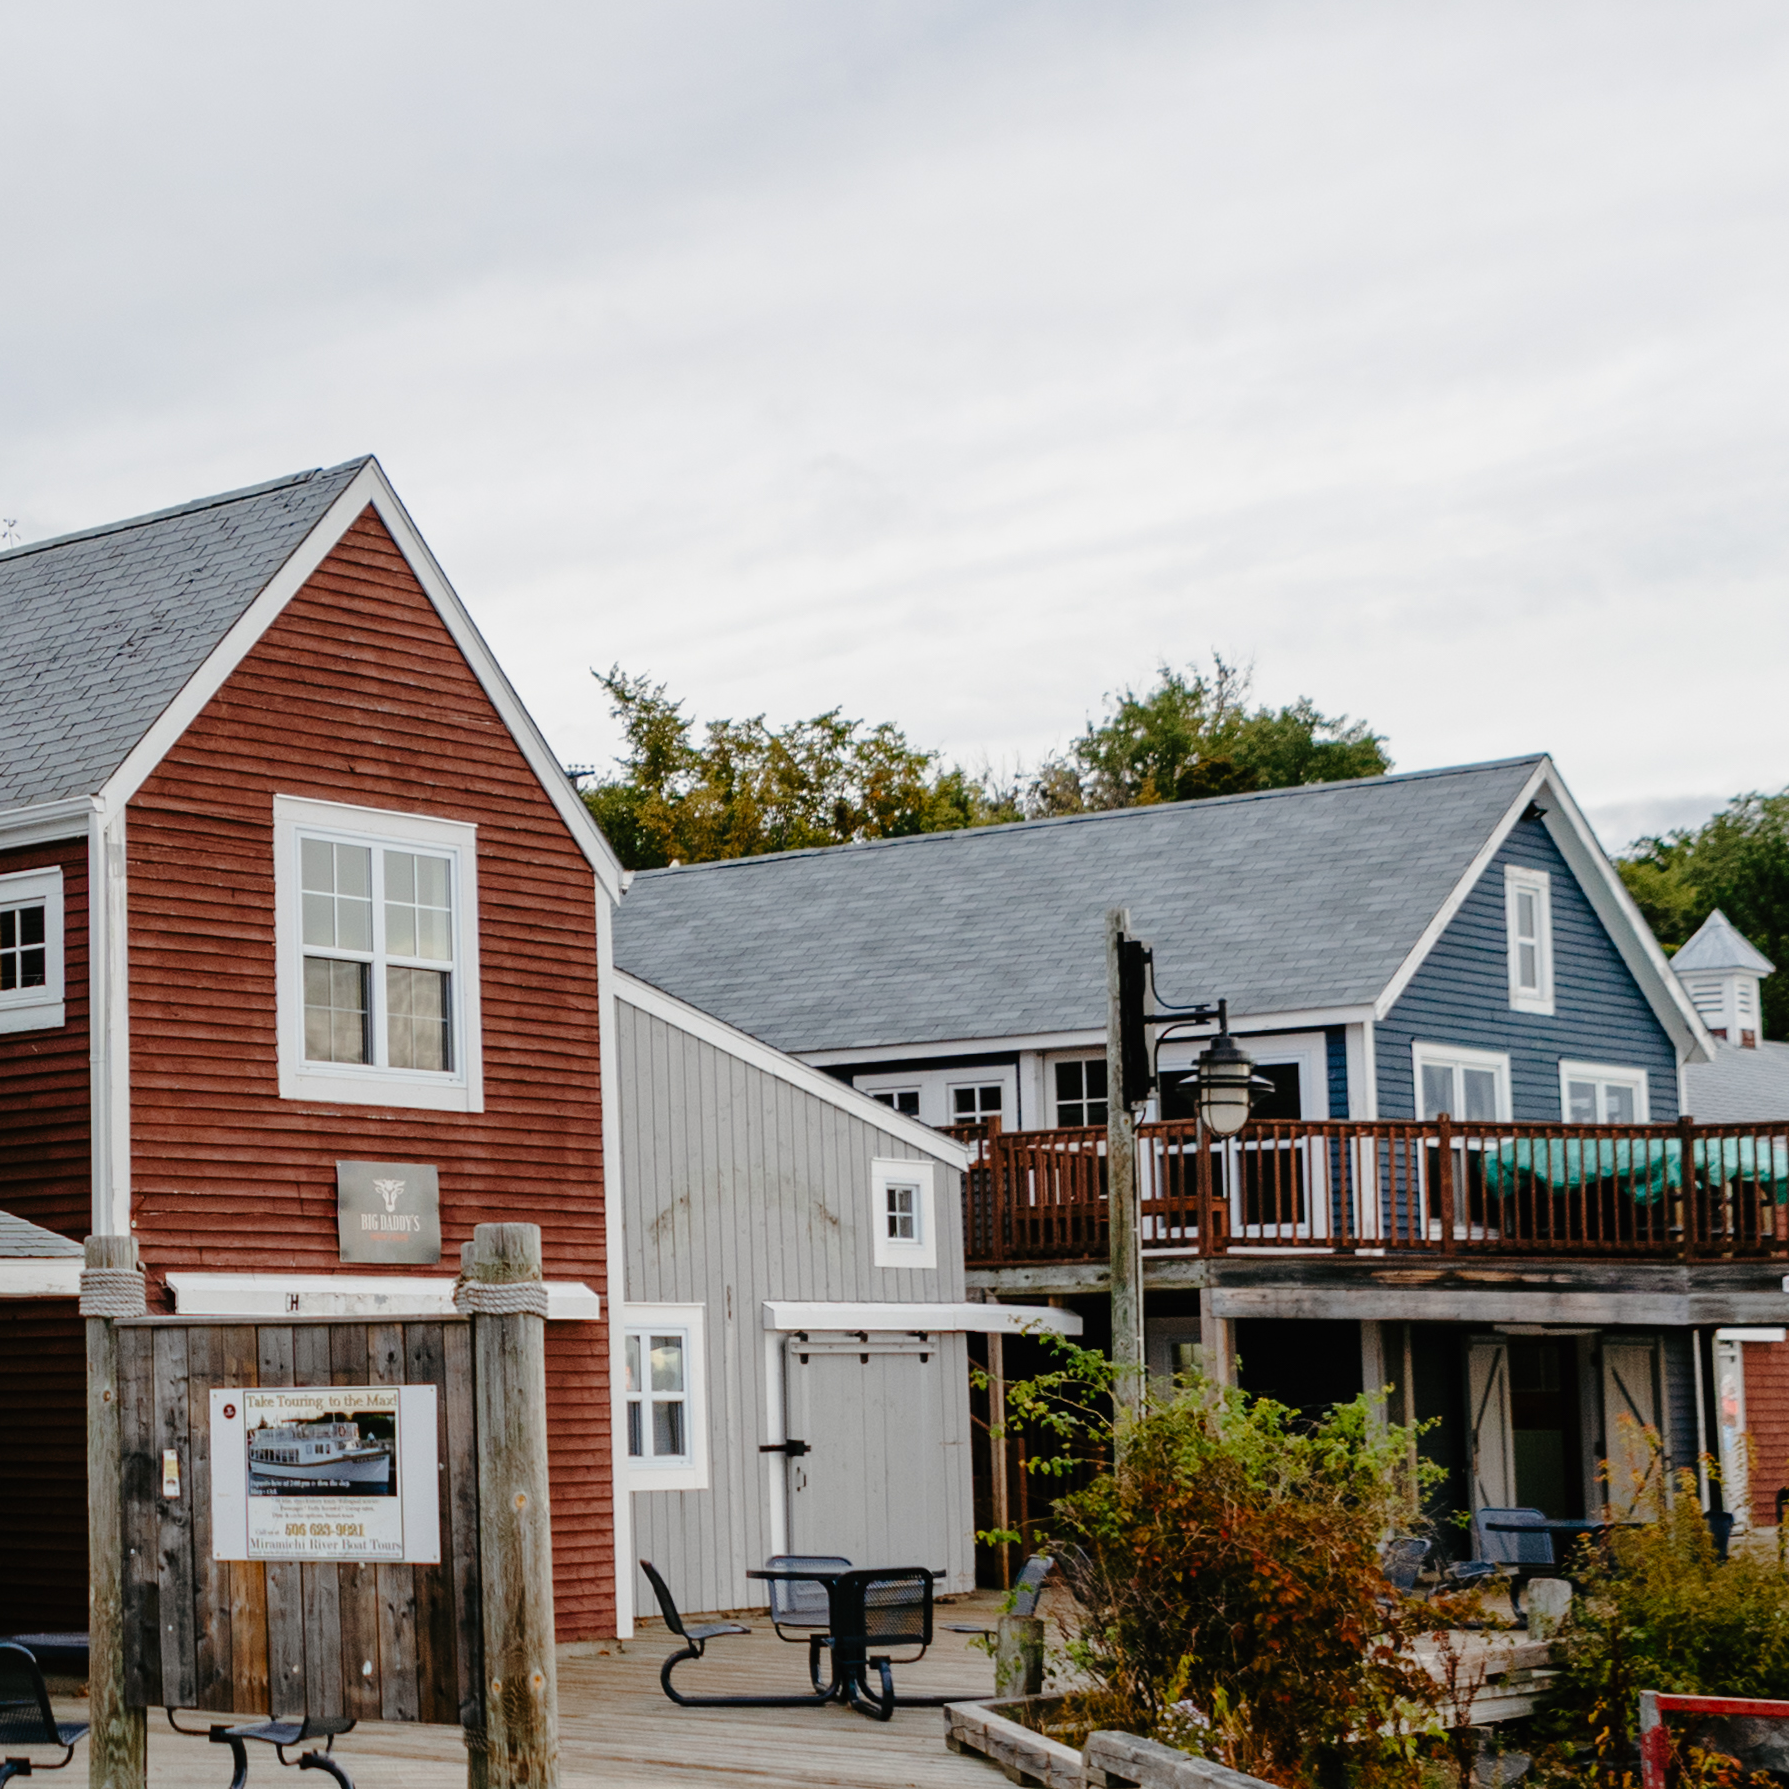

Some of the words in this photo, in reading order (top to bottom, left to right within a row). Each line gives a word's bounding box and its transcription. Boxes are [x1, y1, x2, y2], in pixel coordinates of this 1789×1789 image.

[361, 1214, 378, 1230] BIG
[380, 1214, 420, 1231] DADDY'S
[246, 1396, 274, 1408] Take
[276, 1395, 324, 1410] Touring
[329, 1396, 341, 1406] to
[344, 1394, 363, 1406] the
[366, 1394, 398, 1406] Max!
[285, 1523, 307, 1537] 506
[250, 1538, 305, 1550] Miramichi
[310, 1538, 339, 1550] River
[342, 1538, 367, 1550] Boat
[369, 1539, 402, 1551] Tours
